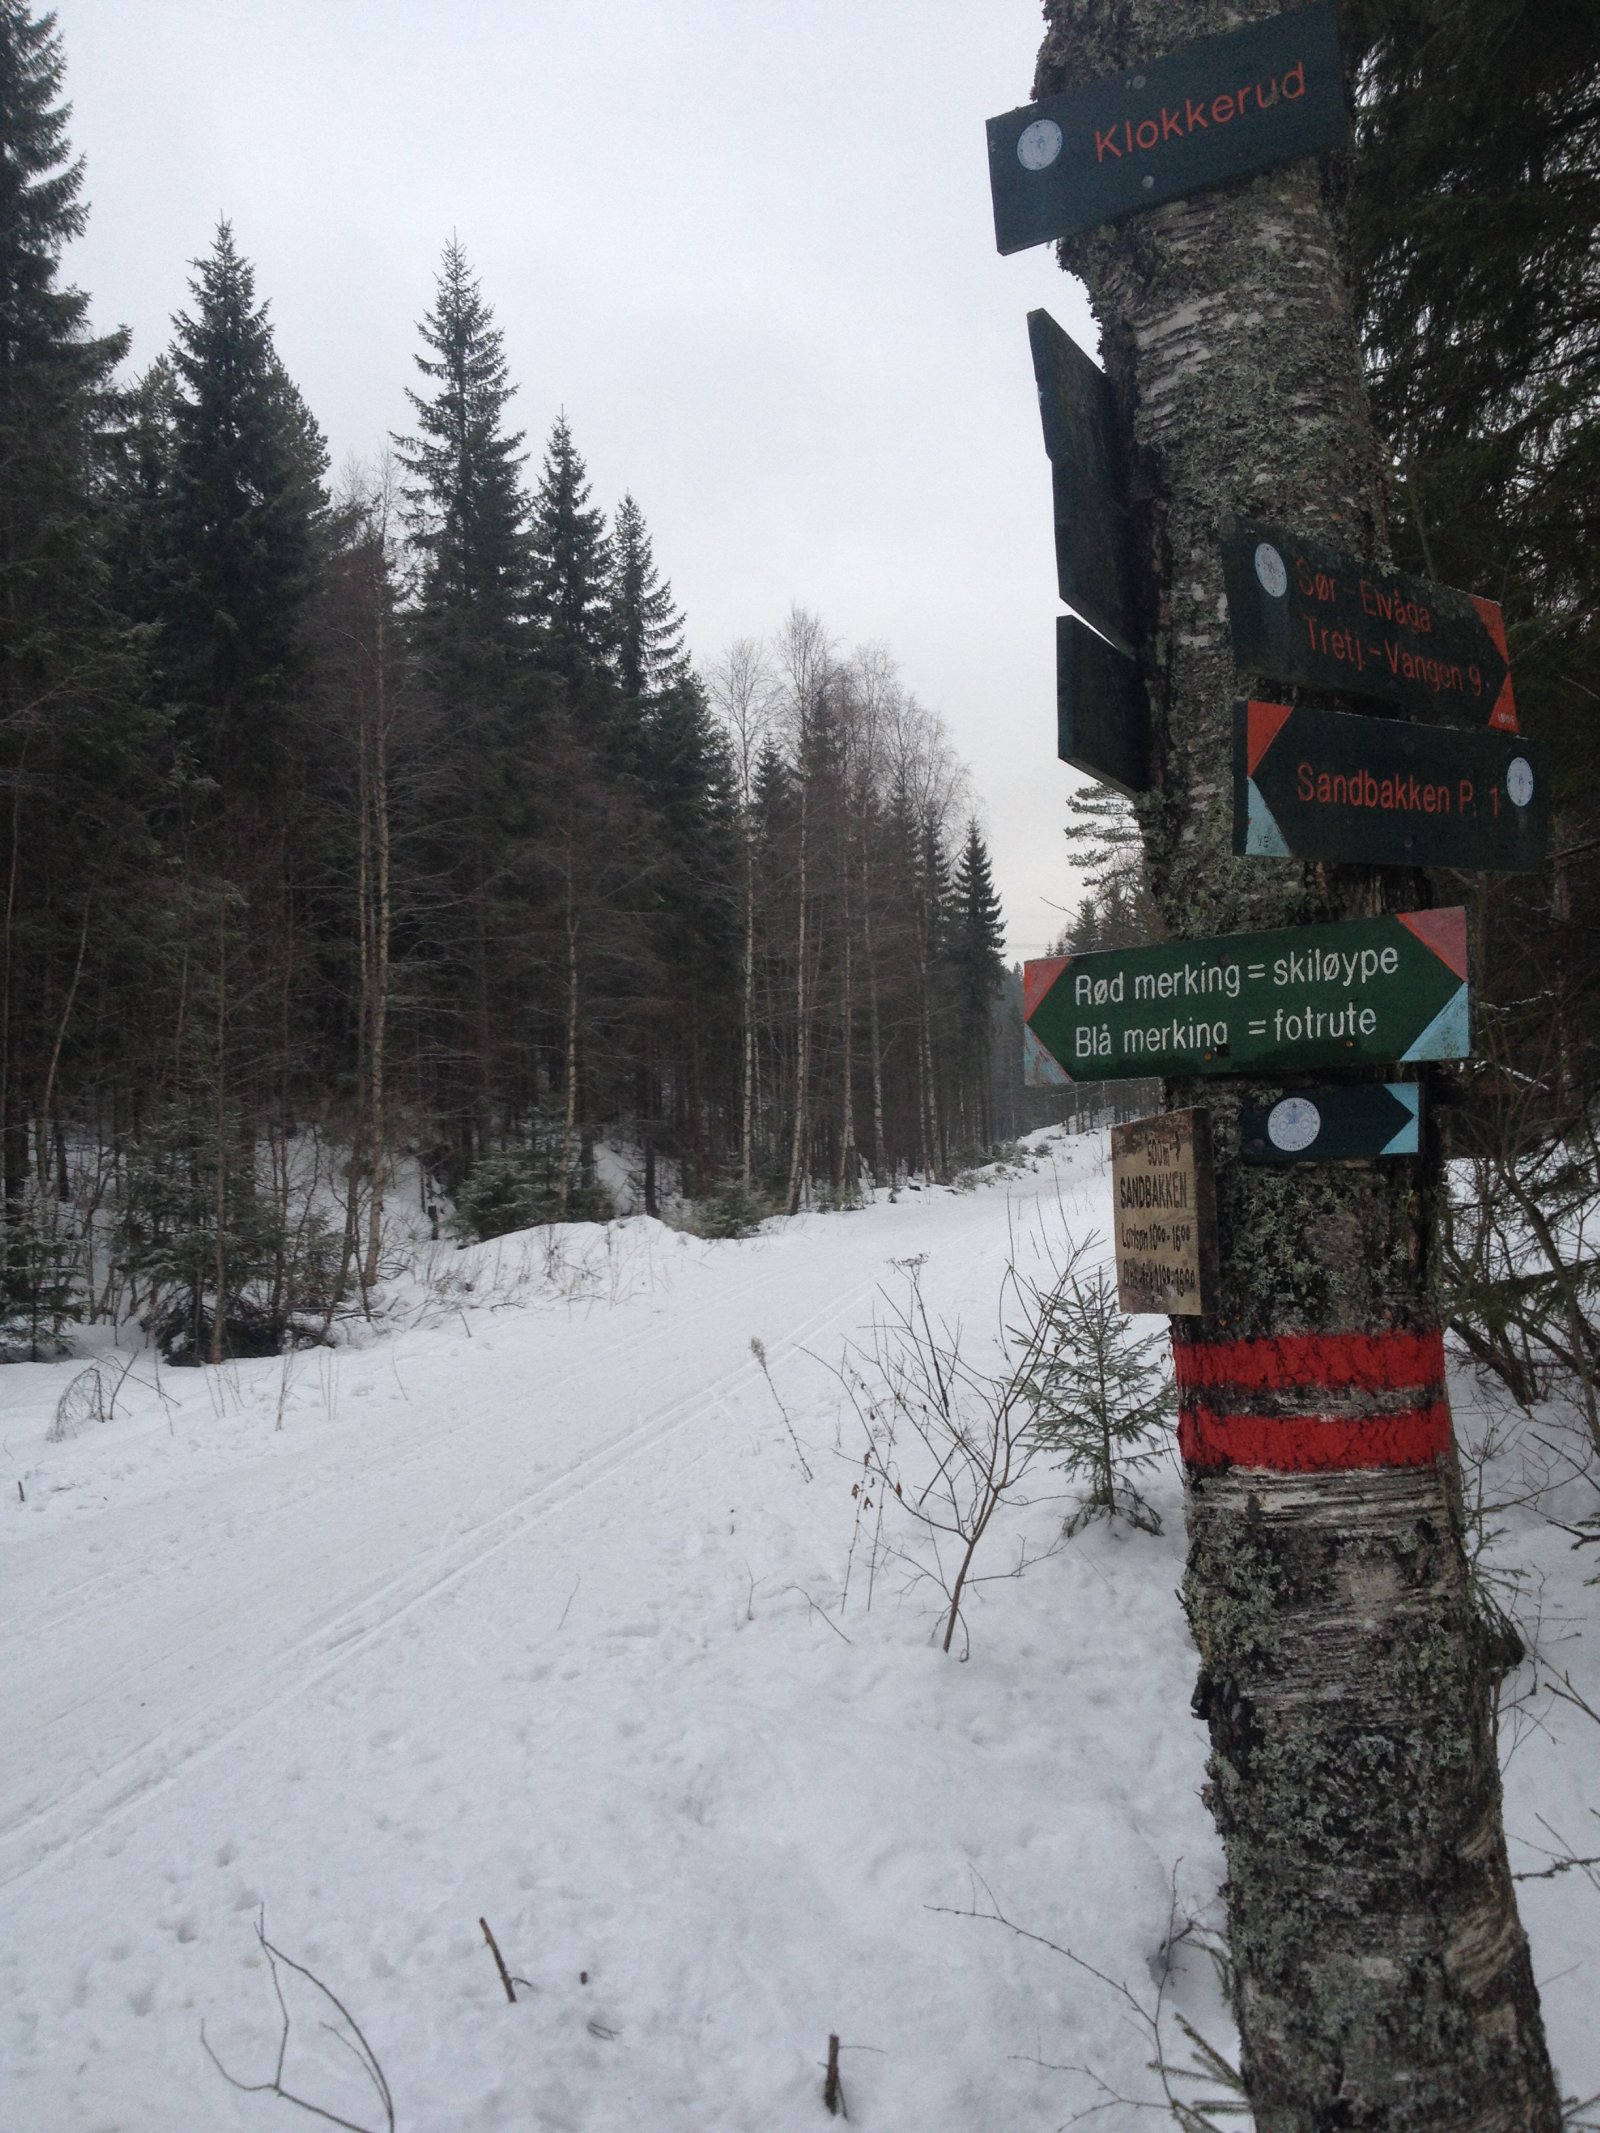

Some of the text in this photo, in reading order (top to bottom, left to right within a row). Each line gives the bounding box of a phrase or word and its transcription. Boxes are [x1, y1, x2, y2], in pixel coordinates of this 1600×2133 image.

[1094, 61, 1306, 163] Klokkerud
[1296, 761, 1451, 814] Sandbakken
[1489, 784, 1500, 817] 1
[1075, 972, 1124, 1006] Rød
[1134, 962, 1240, 998] merking
[1272, 946, 1399, 988] skiløype
[1075, 1022, 1112, 1059] Blå
[1123, 1020, 1229, 1056] merking
[1275, 1002, 1377, 1043] fotrute
[1120, 1171, 1188, 1210] SANDBAKKEN
